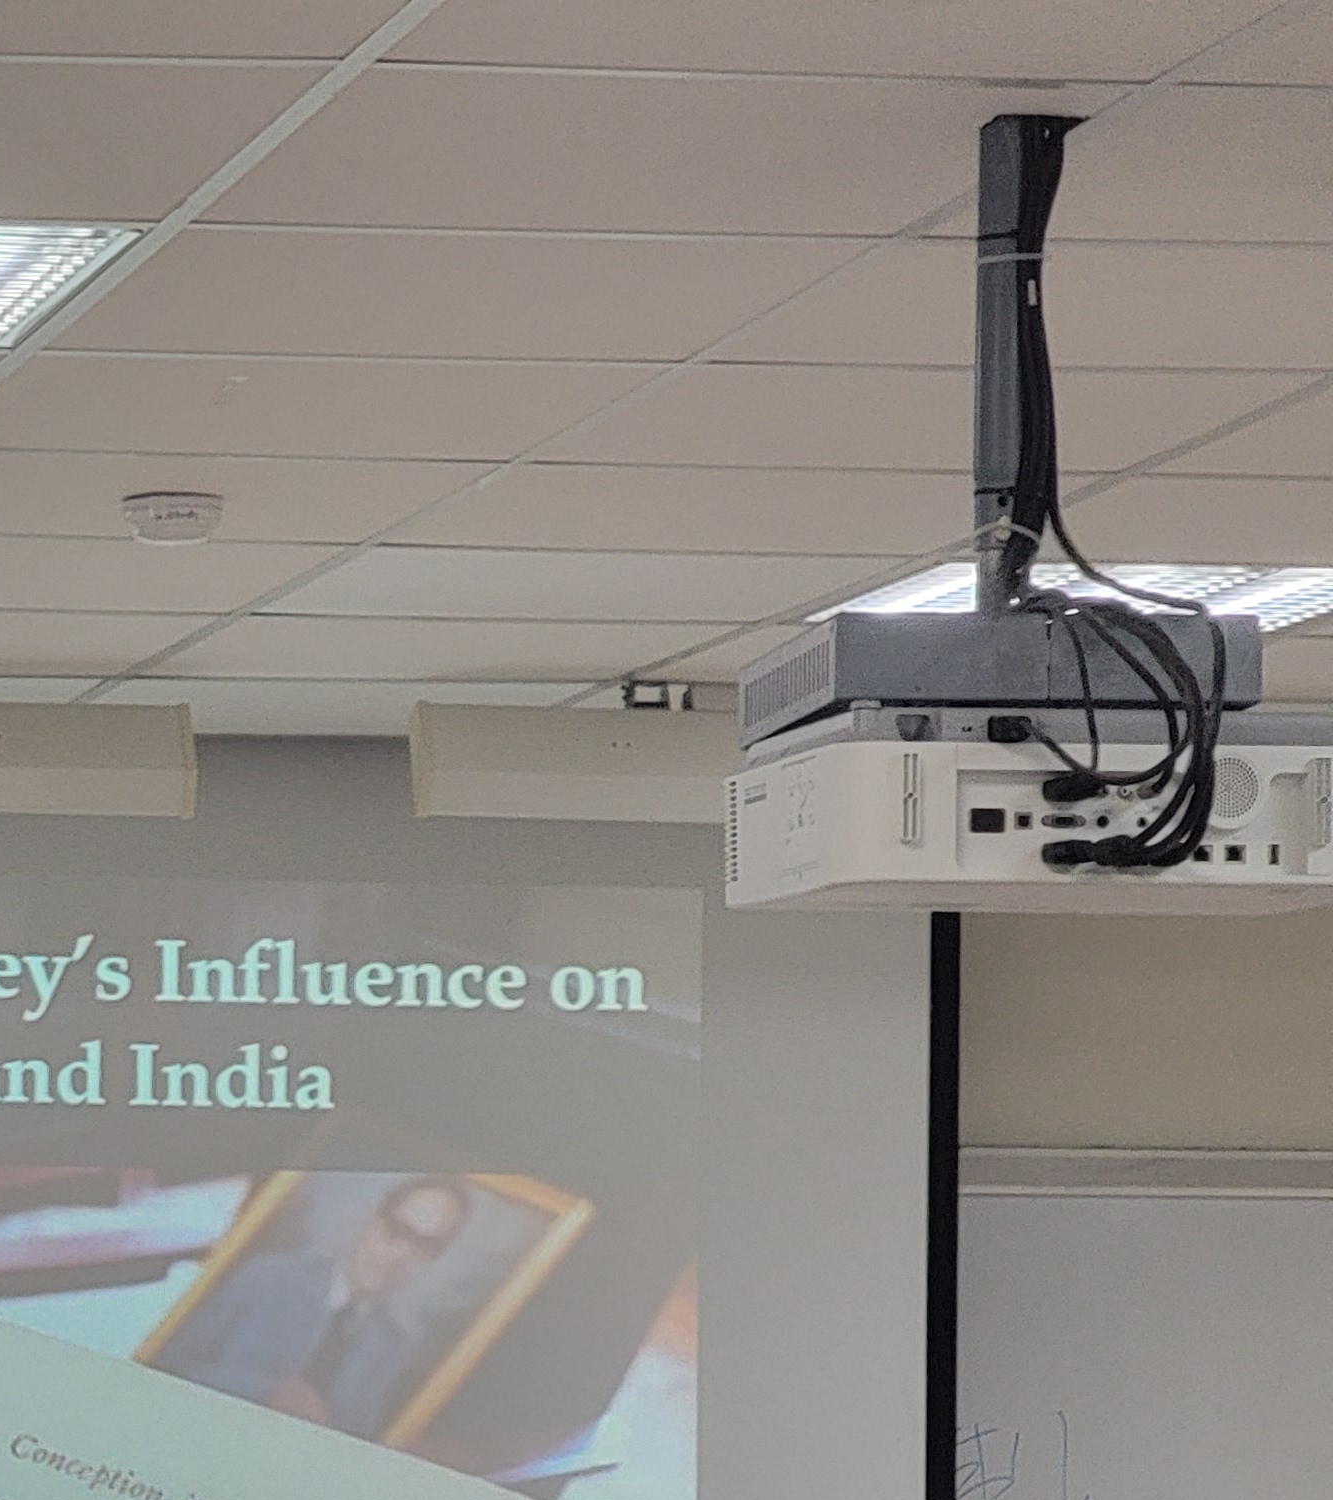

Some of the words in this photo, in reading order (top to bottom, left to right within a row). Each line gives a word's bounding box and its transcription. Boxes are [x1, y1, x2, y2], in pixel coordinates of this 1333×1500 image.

[153, 936, 527, 1009] Influence
[549, 961, 649, 1013] on
[128, 1042, 335, 1110] India
